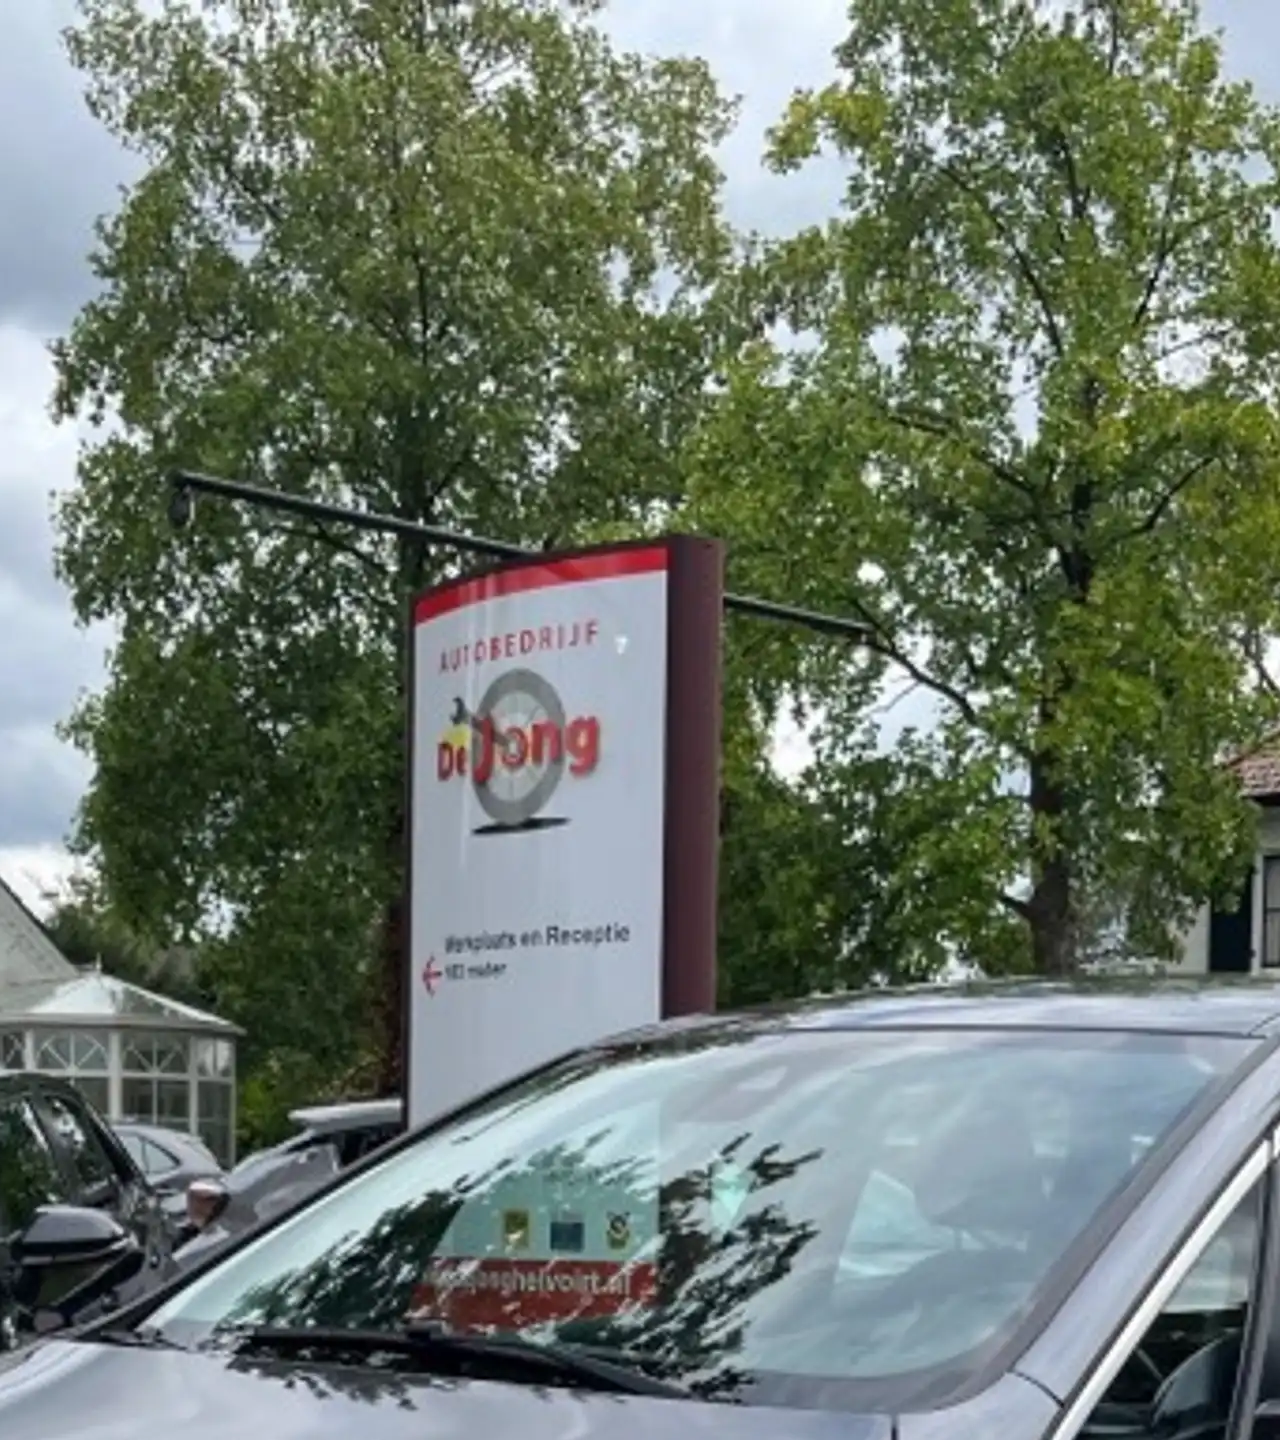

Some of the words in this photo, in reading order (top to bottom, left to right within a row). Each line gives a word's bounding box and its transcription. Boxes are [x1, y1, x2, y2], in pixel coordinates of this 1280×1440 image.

[439, 618, 599, 674] AUTOBEDRIJF
[521, 928, 543, 947] en
[545, 921, 630, 948] Receptie
